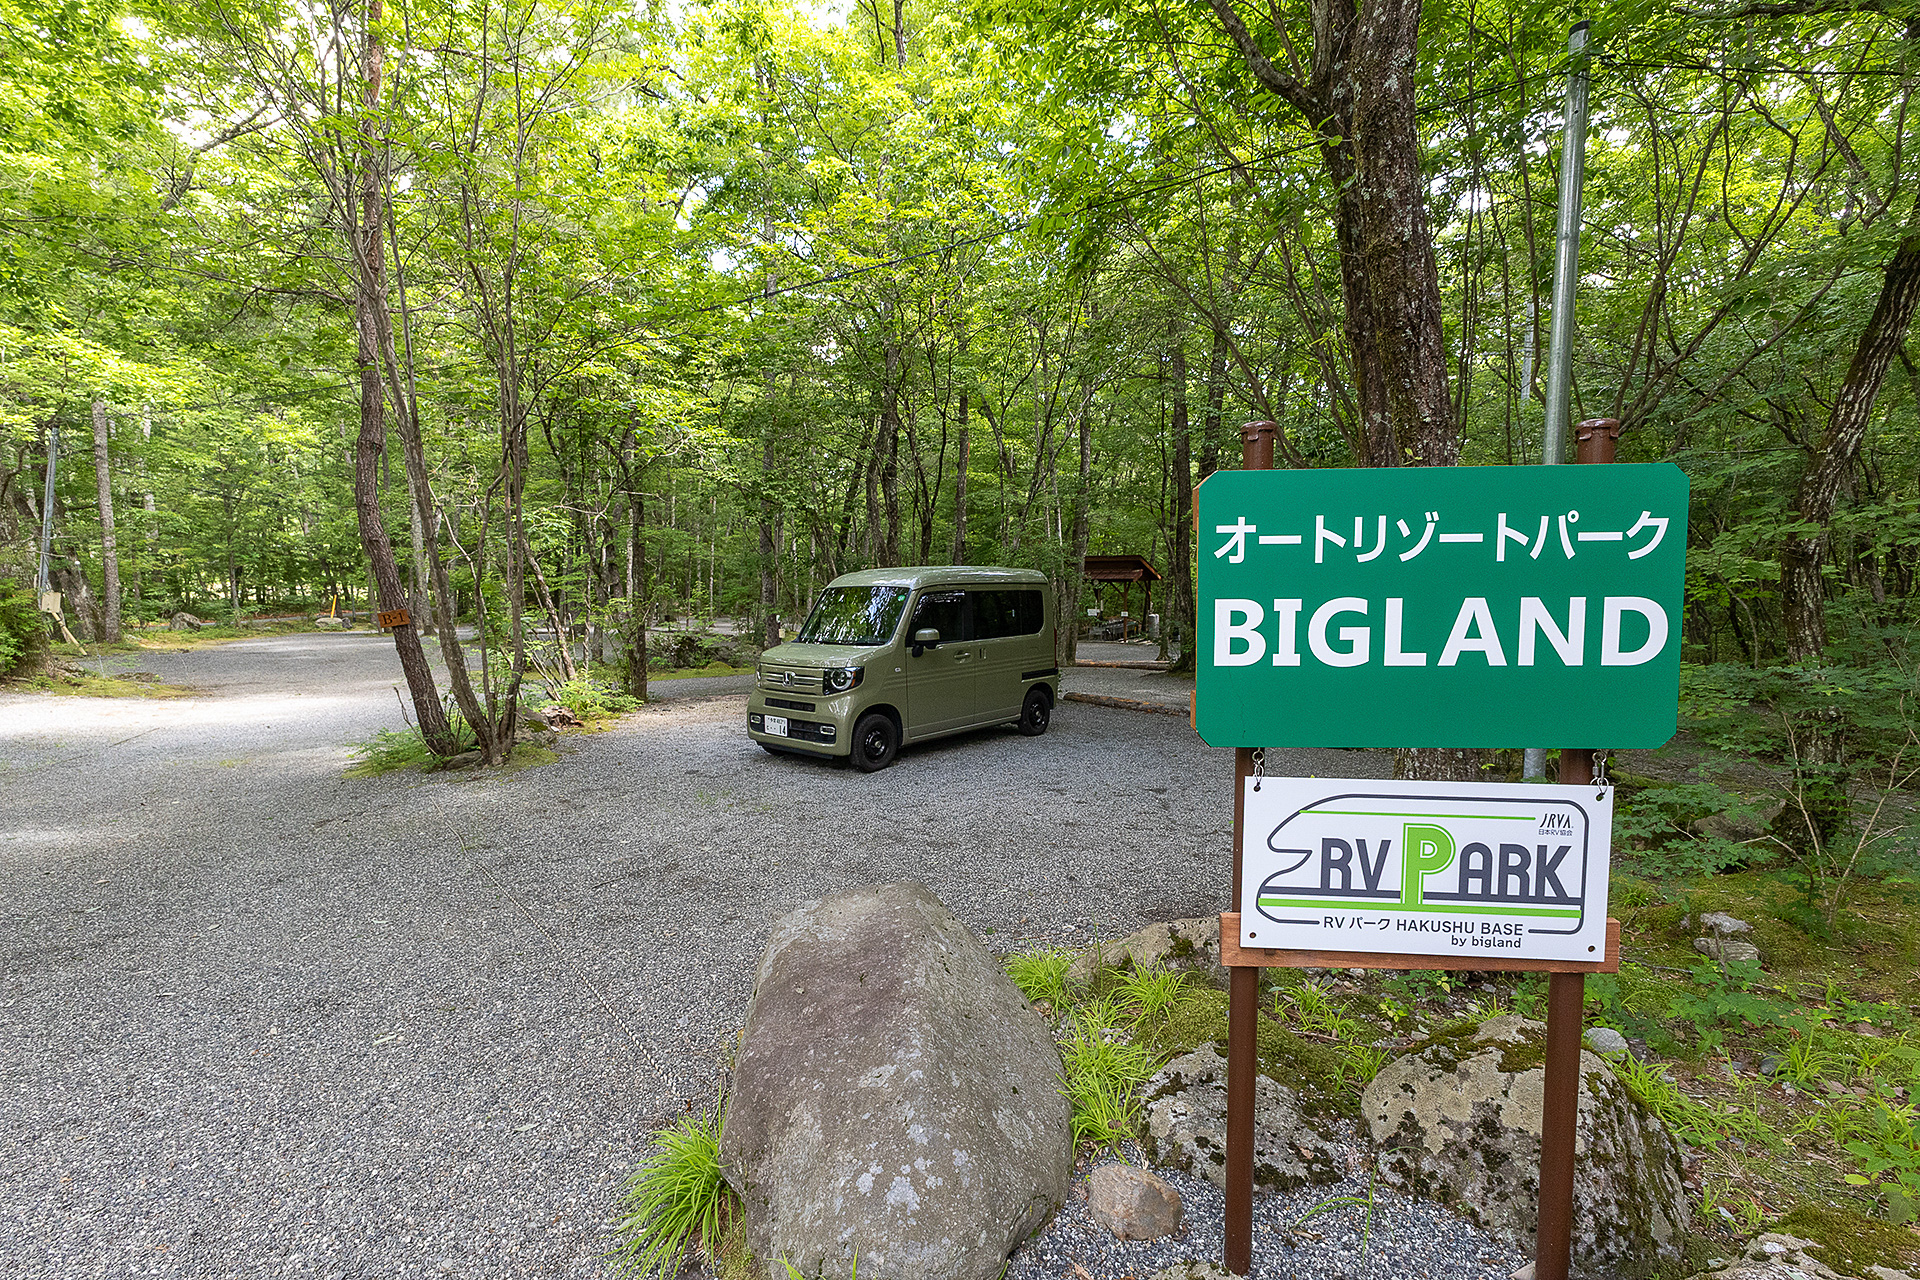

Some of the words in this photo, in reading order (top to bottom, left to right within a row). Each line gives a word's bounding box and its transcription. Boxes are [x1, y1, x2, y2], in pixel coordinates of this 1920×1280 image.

[1214, 510, 1670, 564] オートリゾートパーク
[382, 612, 405, 625] B-1
[1214, 597, 1669, 668] BIGLAND
[1539, 813, 1571, 829] JRVA
[1320, 837, 1392, 893] RV
[1401, 822, 1572, 904] PARK
[1323, 916, 1346, 930] RV
[1349, 916, 1391, 931] パーク
[1396, 918, 1475, 935] HAKUSHU
[1481, 922, 1524, 937] BASE
[1451, 935, 1467, 948] by
[1472, 935, 1522, 949] bigland
